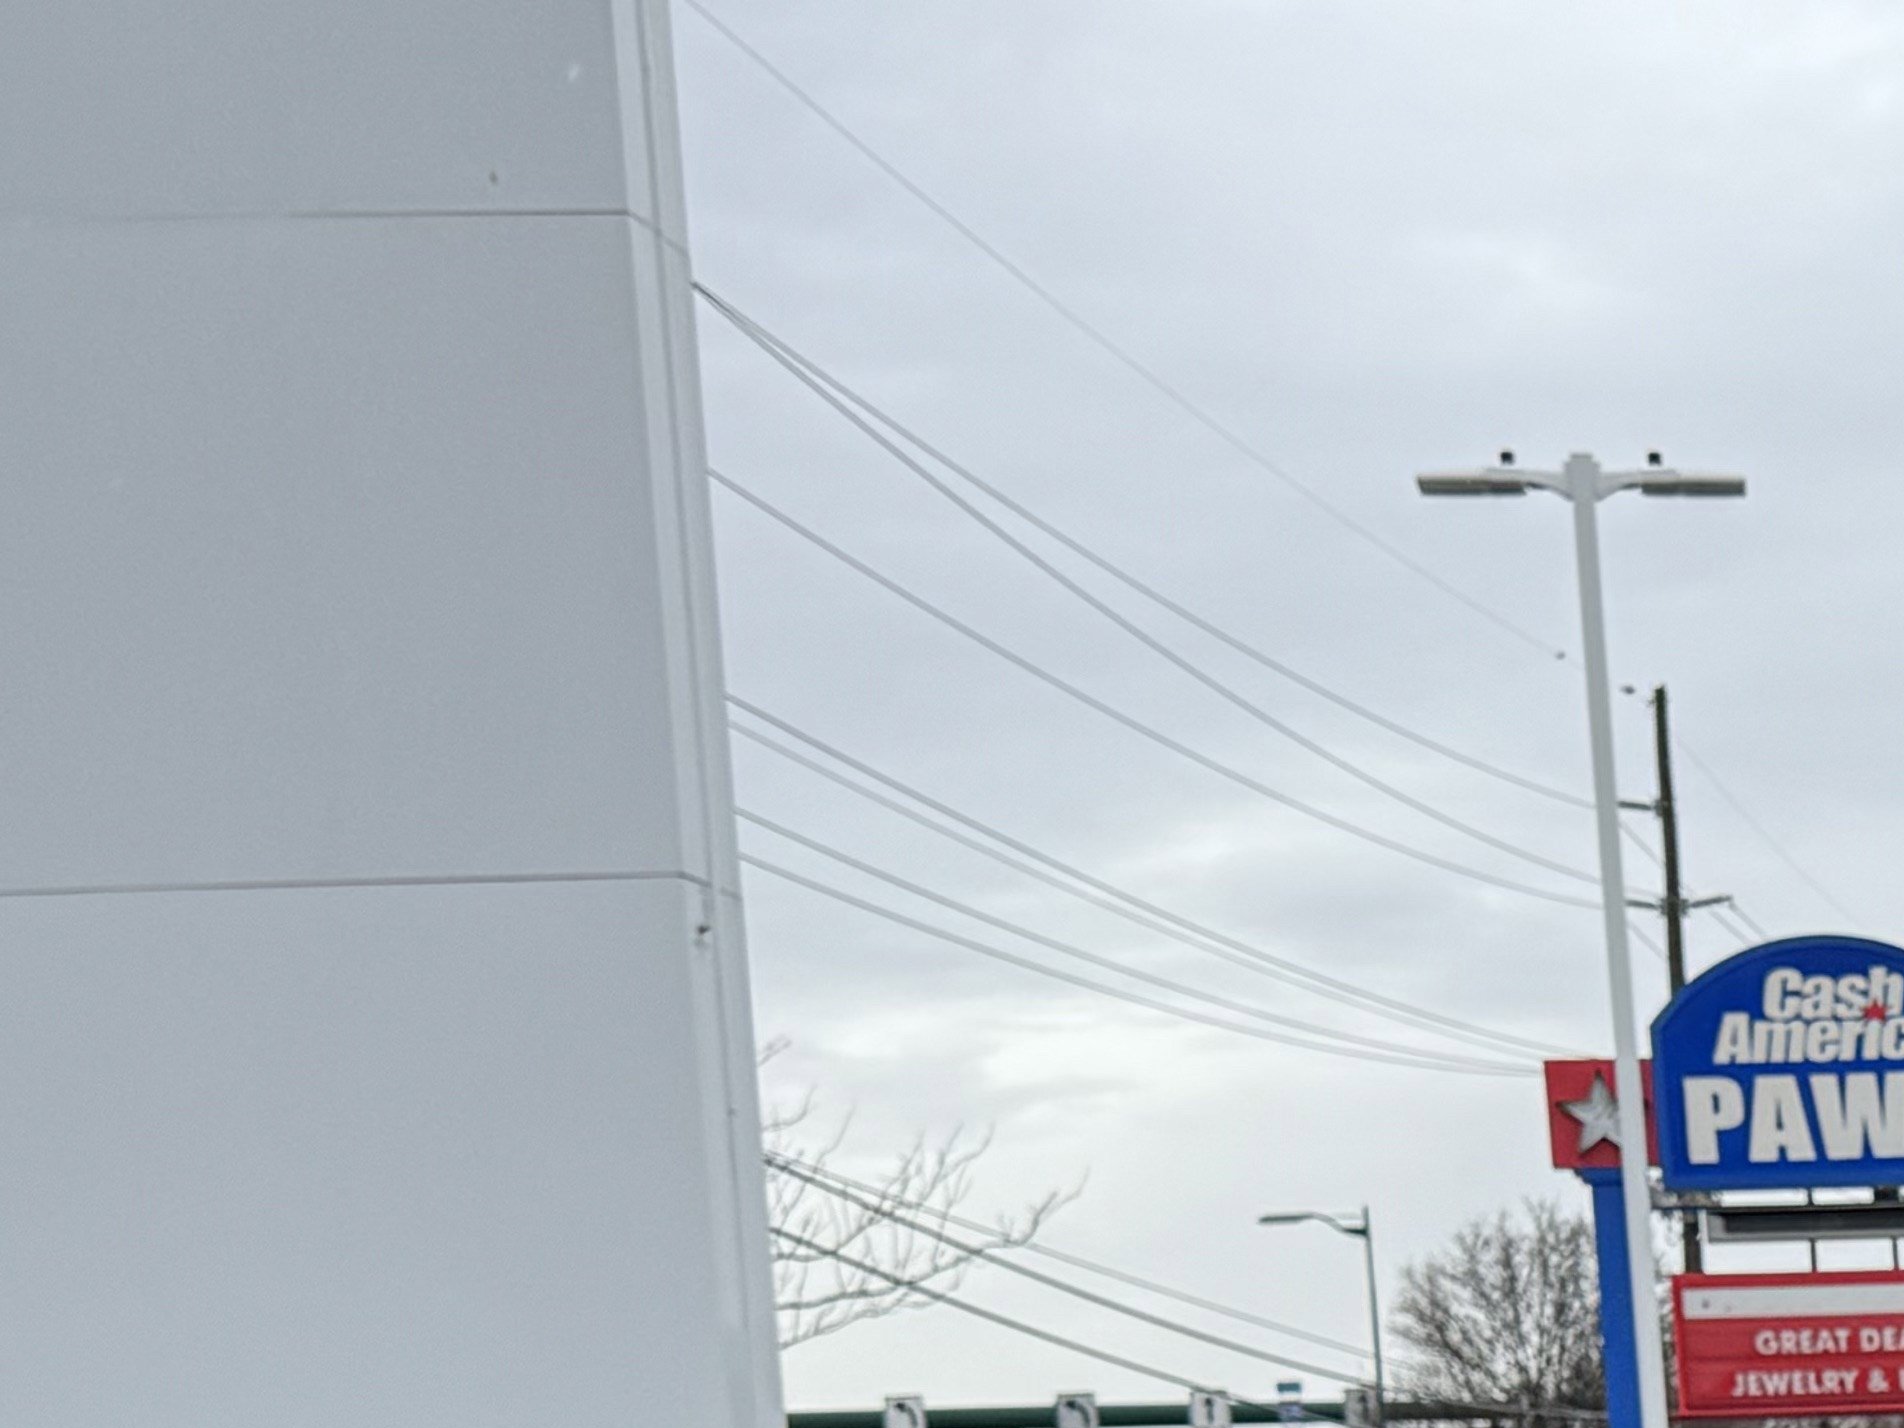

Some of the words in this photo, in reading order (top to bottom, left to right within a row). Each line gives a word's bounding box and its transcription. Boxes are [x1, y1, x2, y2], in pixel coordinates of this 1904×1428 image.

[1762, 965, 1904, 1021] Cash
[1754, 1327, 1851, 1356] GREAT
[1731, 1367, 1860, 1398] JEWELRY
[1867, 1366, 1889, 1393] &
